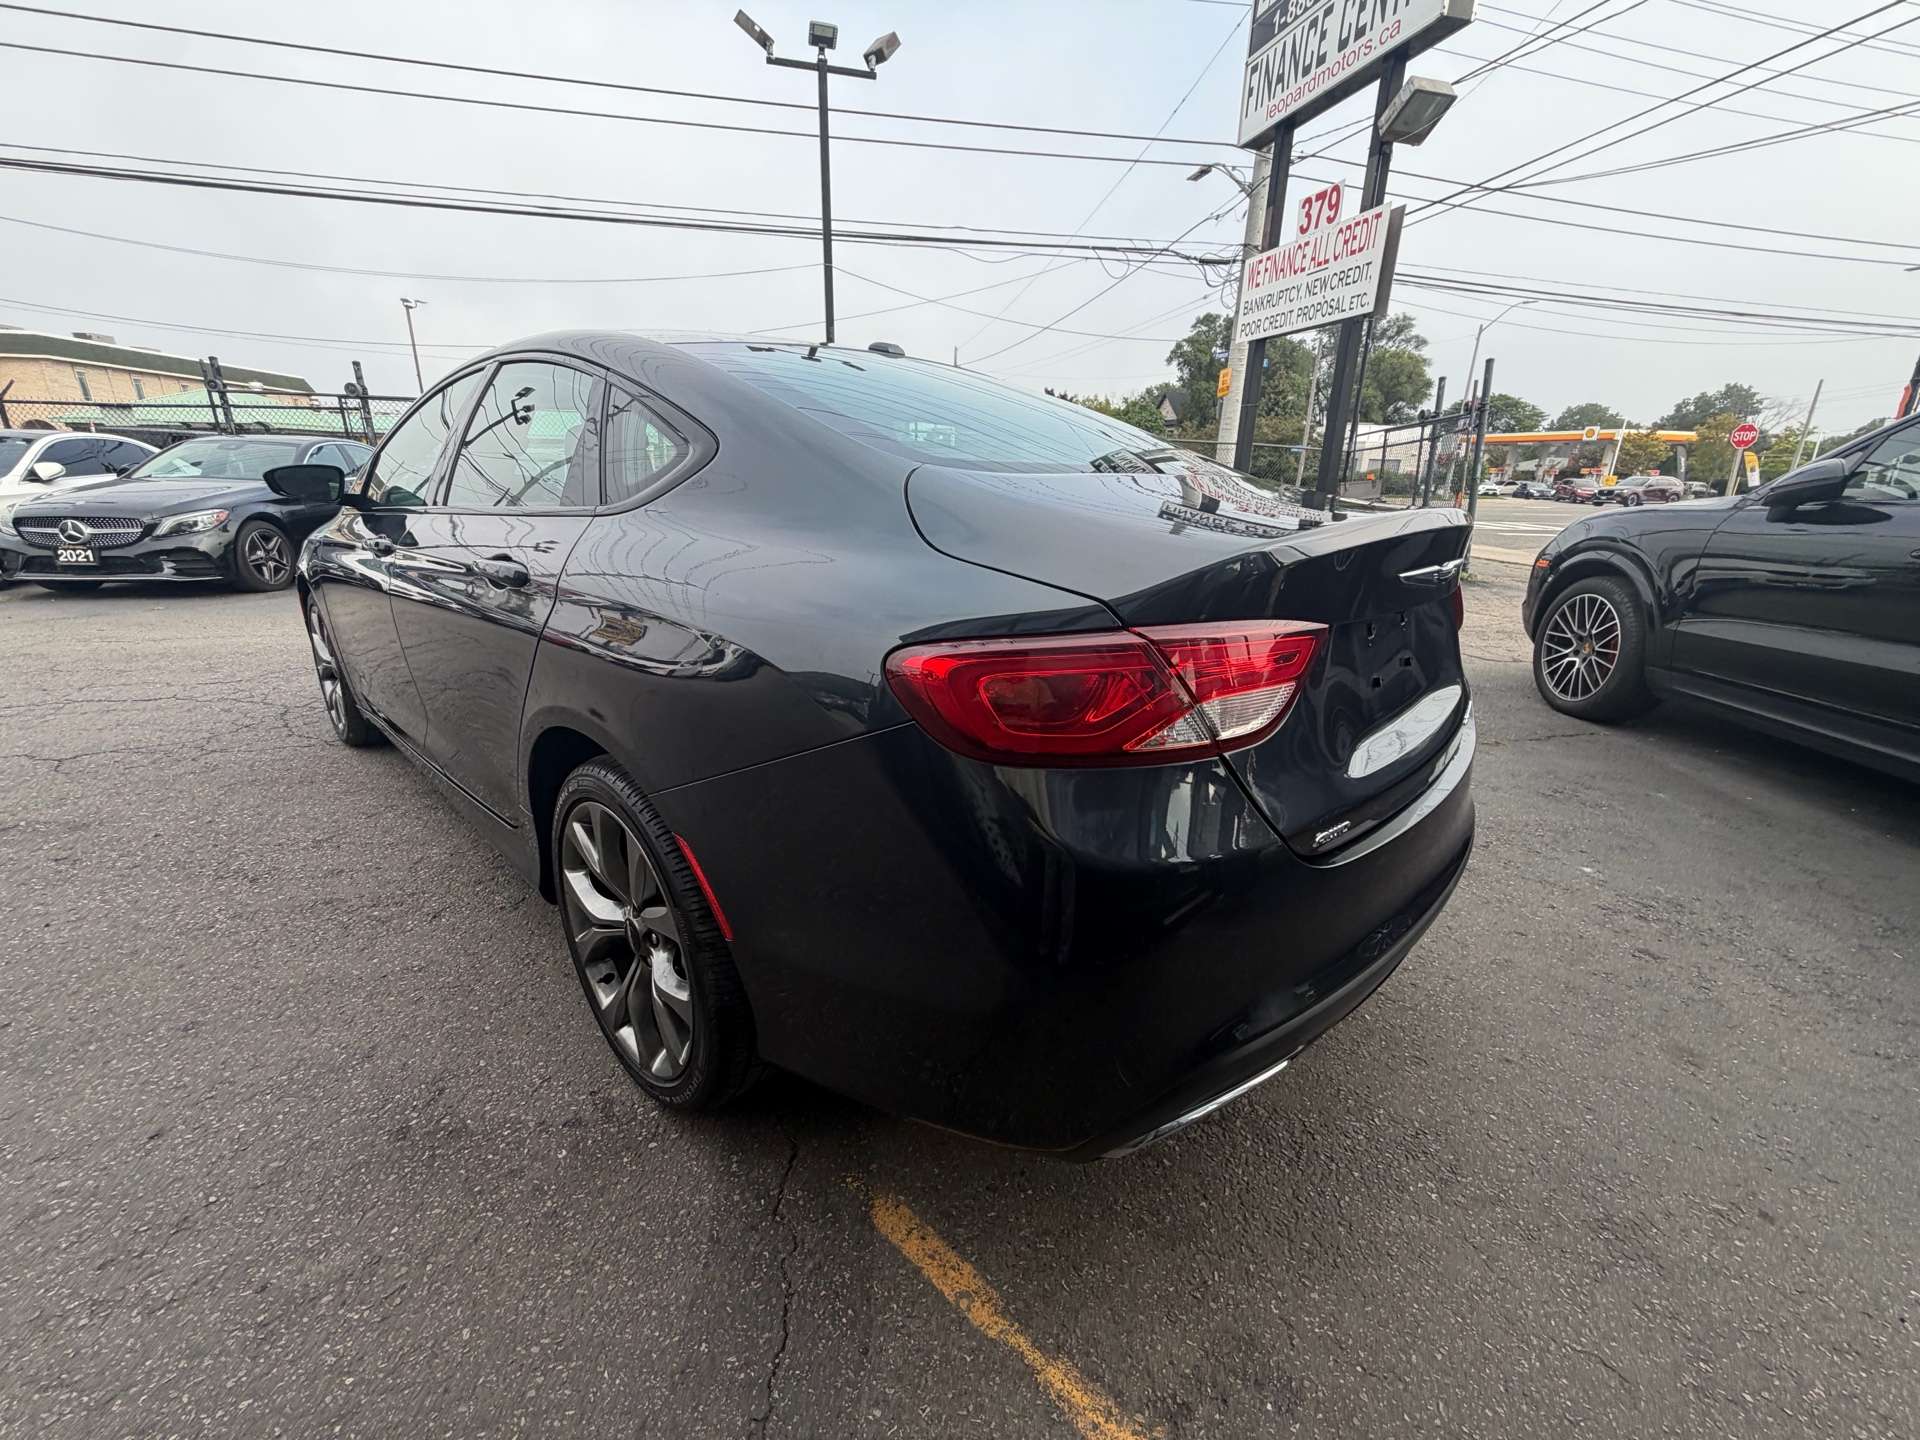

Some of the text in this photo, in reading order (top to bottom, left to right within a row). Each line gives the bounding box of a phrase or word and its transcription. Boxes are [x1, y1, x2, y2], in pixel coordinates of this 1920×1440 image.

[1245, 2, 1334, 119] FINANCE
[1265, 19, 1401, 121] leopardmotors.ca
[1299, 184, 1341, 235] 379
[1247, 212, 1383, 291] WE FINANCE ALL CREDIT
[1304, 275, 1331, 299] NEW
[1240, 318, 1262, 339] POOR
[1296, 295, 1347, 325] PROPOSAL
[1349, 292, 1370, 311] ETC.
[1733, 431, 1757, 442] STOP
[57, 549, 95, 562] 2021
